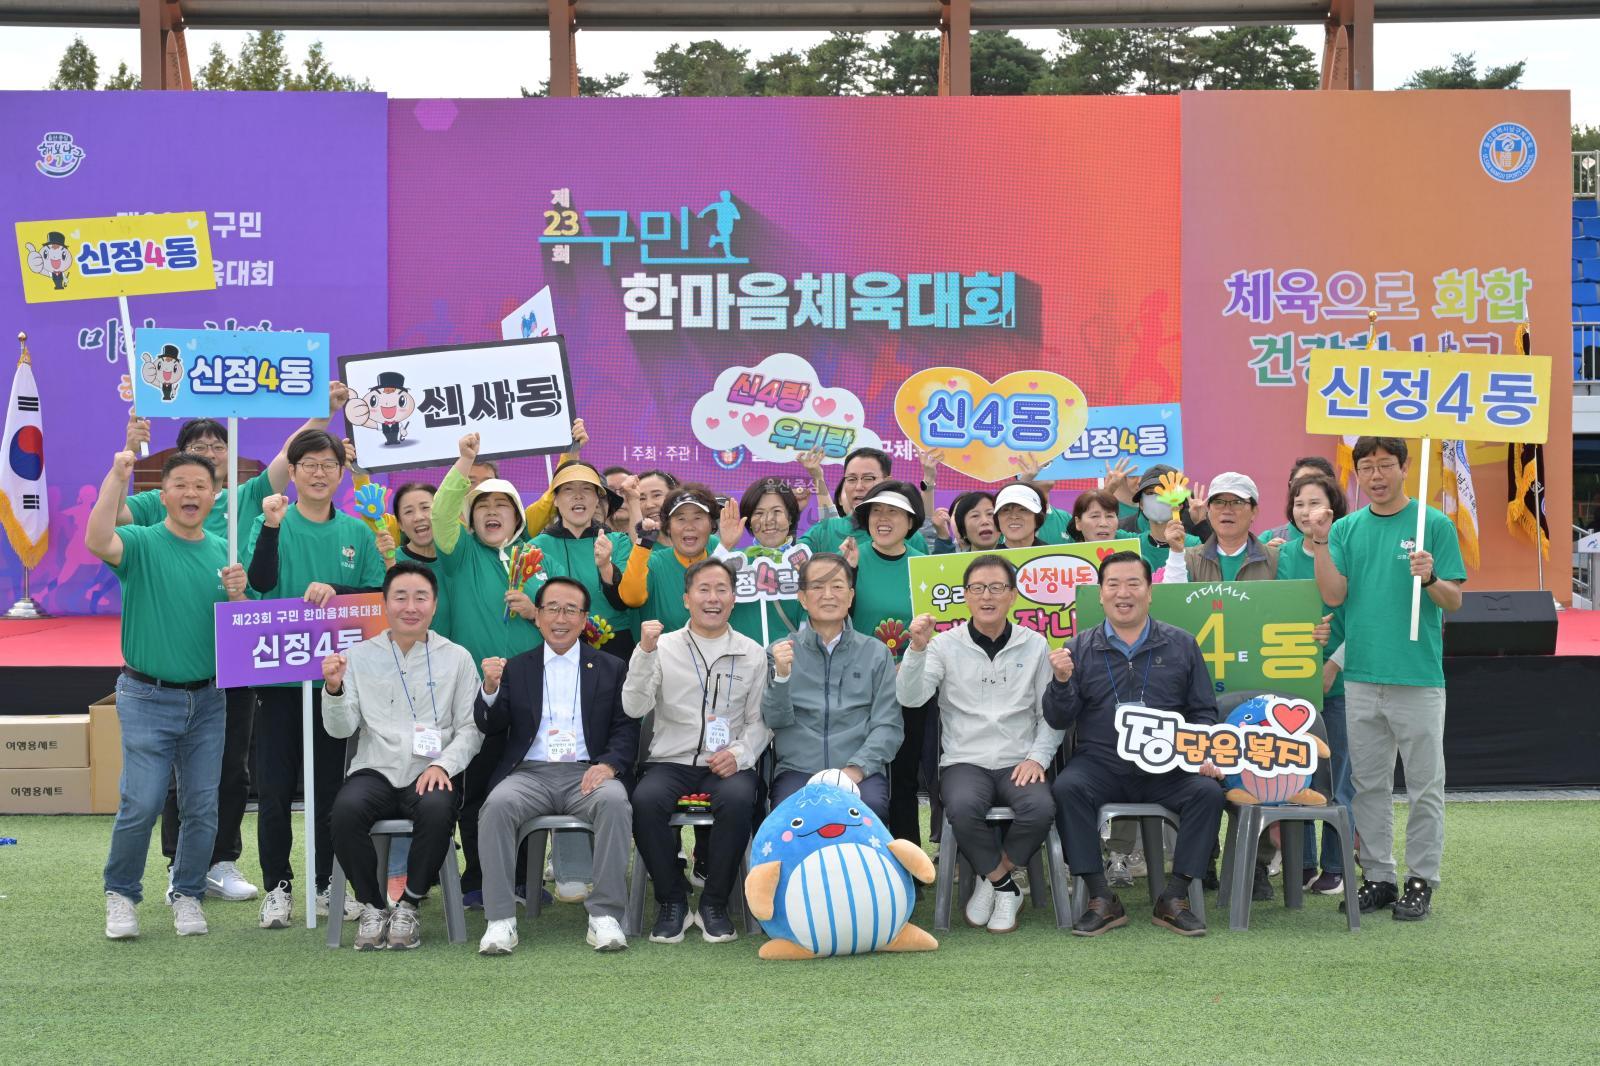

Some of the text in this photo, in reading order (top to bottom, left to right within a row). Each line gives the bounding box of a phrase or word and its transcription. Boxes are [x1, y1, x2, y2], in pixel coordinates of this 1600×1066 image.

[212, 211, 262, 239] 구민
[543, 209, 579, 236] 23
[570, 206, 749, 266] 구민
[77, 236, 198, 276] 신정4동
[620, 271, 1017, 331] 한마음체육대회
[1224, 268, 1531, 324] 체육으로 화합
[188, 356, 314, 395] 신정4동
[727, 373, 811, 413] 신4랑
[1320, 366, 1538, 427] 신정4동
[769, 418, 855, 459] 우리랑
[928, 396, 1051, 443] 신4동
[1019, 566, 1093, 594] 신정4동
[1185, 583, 1251, 604] 어디서나
[232, 604, 382, 627] 제23회 구민 한마음체육대회
[1212, 599, 1223, 610] N
[1238, 650, 1249, 662] E
[1245, 732, 1310, 771] 복지
